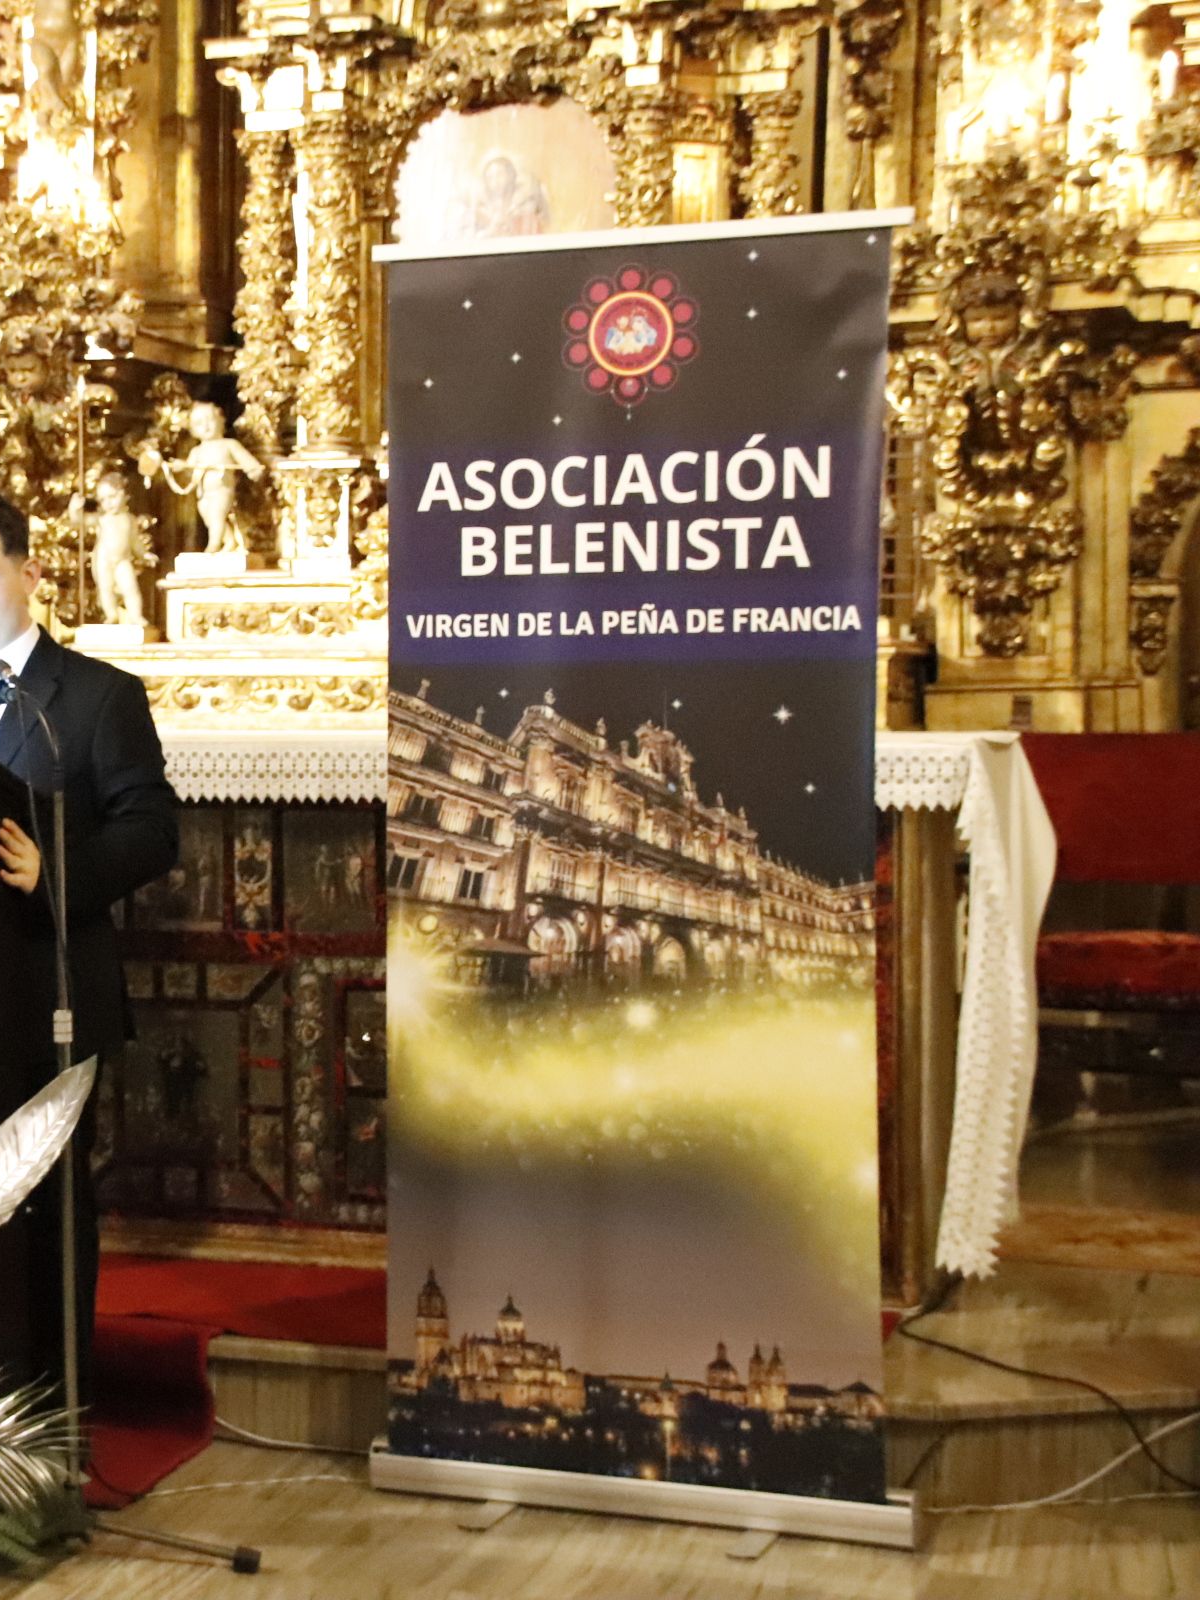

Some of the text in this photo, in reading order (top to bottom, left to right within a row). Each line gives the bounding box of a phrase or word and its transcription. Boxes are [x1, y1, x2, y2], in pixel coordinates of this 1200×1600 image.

[417, 433, 831, 512] ASOCIACIÓN
[460, 515, 811, 577] BELENISTA
[406, 604, 862, 638] VIRGEN DE LA PEÑA DE FRANCIA
